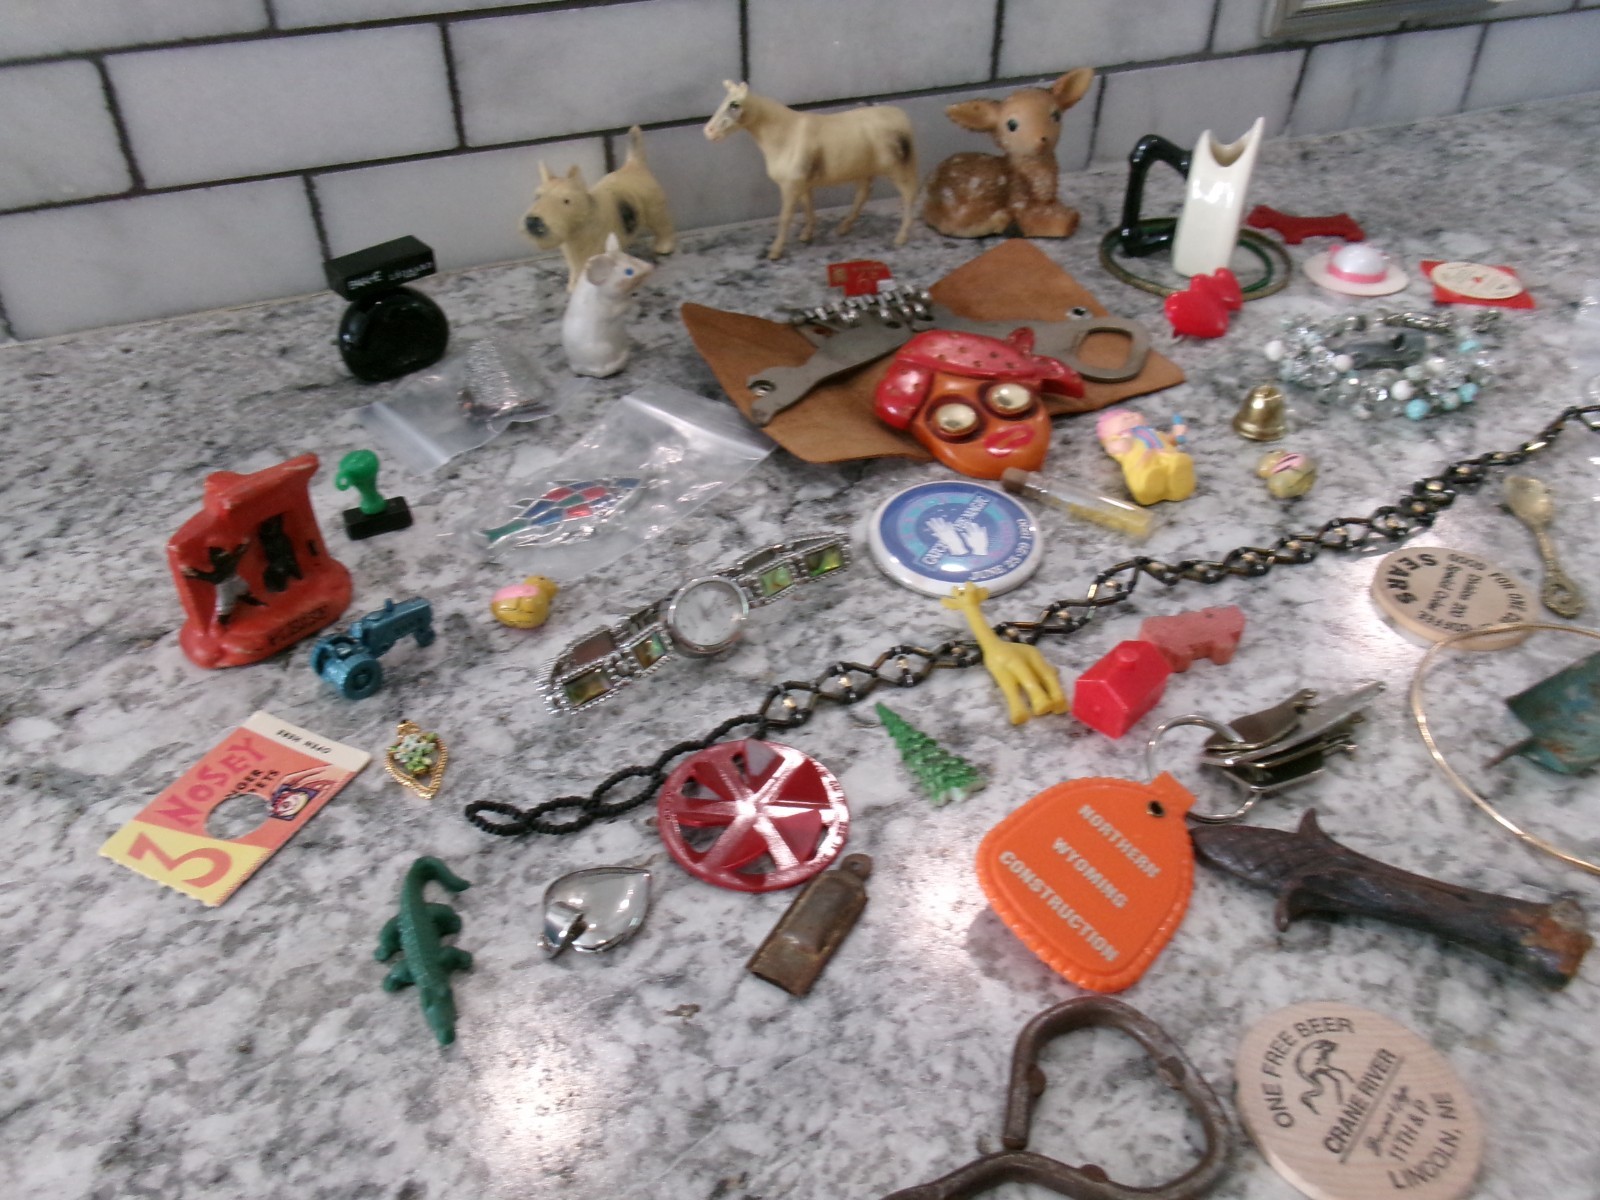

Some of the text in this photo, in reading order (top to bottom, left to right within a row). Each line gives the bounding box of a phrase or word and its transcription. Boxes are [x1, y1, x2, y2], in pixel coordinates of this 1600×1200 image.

[1386, 553, 1439, 604] SEARS
[1488, 572, 1516, 589] FOR
[1507, 593, 1528, 612] ONE
[154, 736, 267, 827] NOSEY
[127, 831, 232, 889] 3
[1052, 837, 1129, 908] WYOMING
[1078, 804, 1161, 878] NORTHERN
[999, 850, 1120, 962] CONSTRUCTION
[1261, 1016, 1355, 1128] ONE FREE BEER
[1323, 1093, 1372, 1154] CRANE
[1356, 1048, 1398, 1098] RIVER
